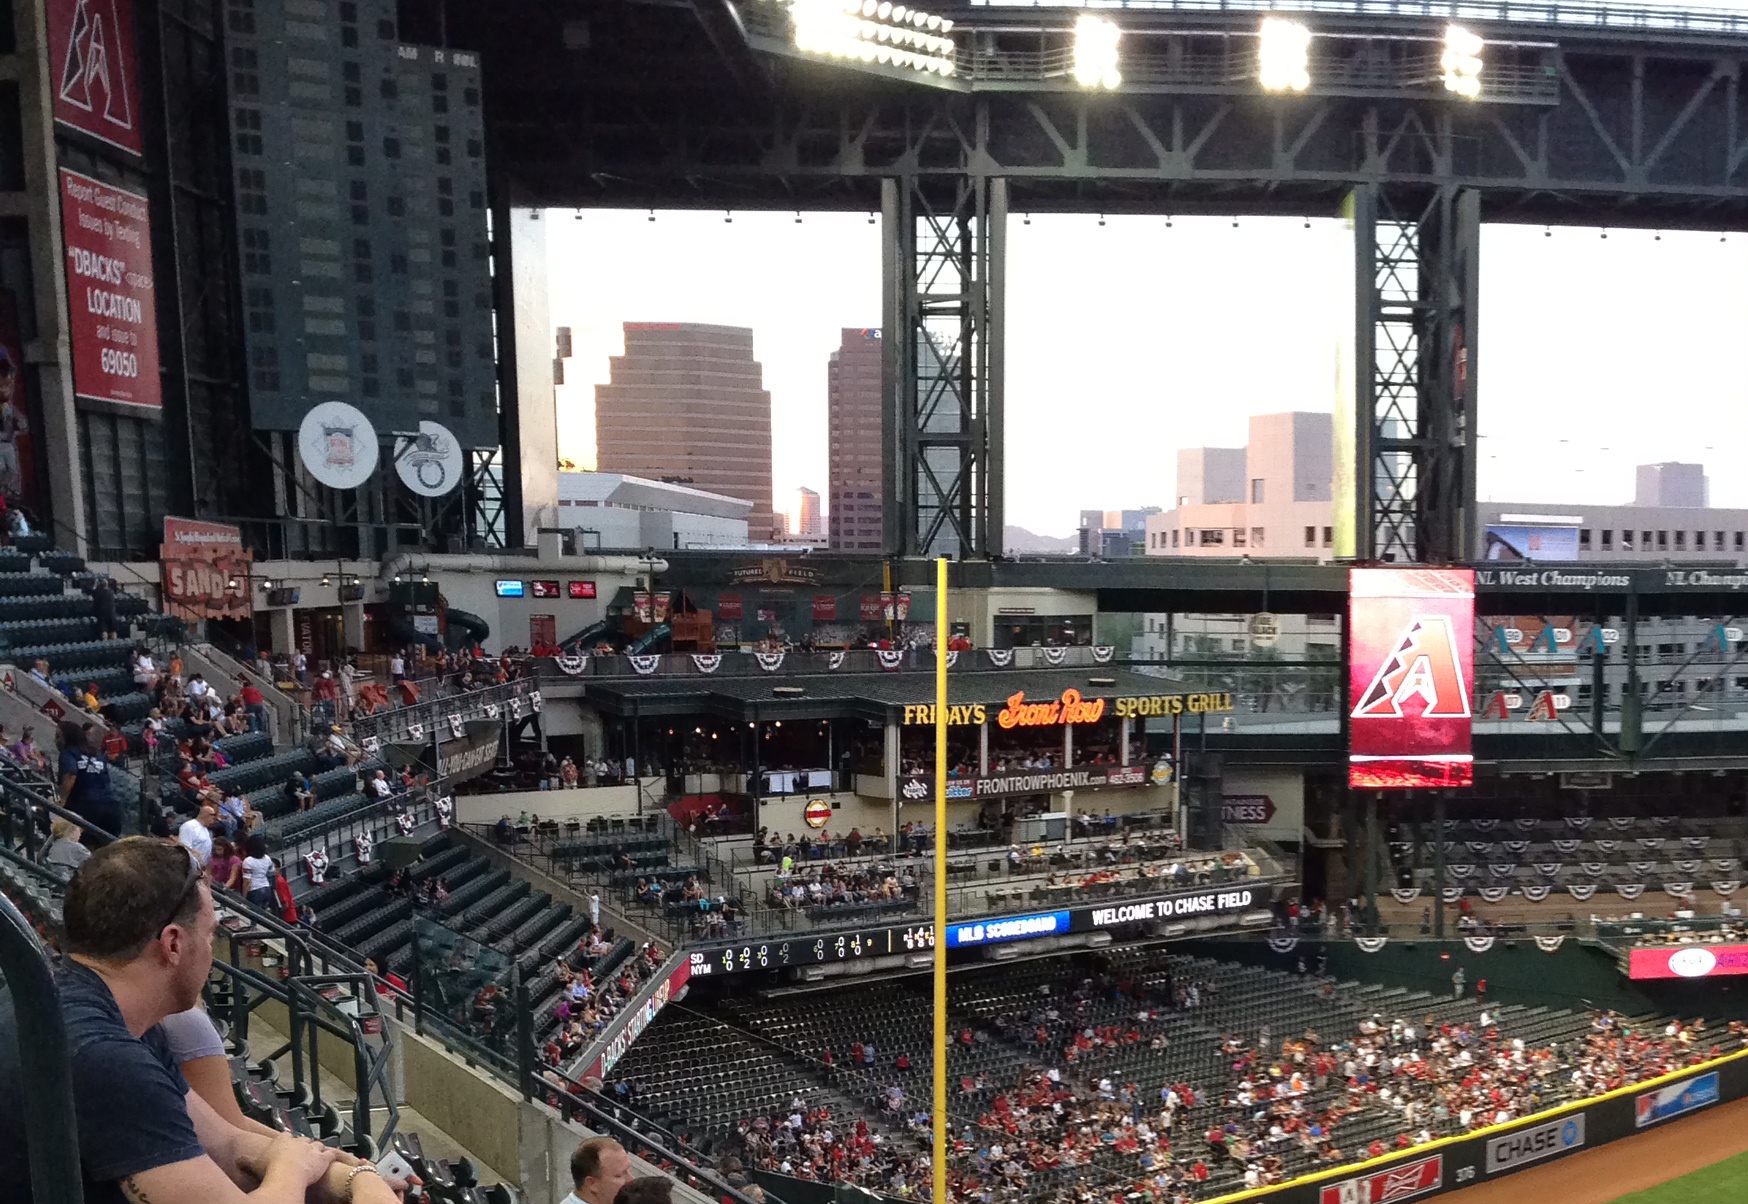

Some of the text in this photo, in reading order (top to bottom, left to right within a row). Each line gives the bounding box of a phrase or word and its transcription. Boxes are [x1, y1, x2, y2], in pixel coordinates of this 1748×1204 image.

[66, 176, 148, 222] Report Guest Conduct
[78, 208, 103, 232] Issues
[114, 221, 141, 249] Texting
[87, 287, 142, 324] LOCATION
[96, 325, 110, 340] and
[101, 347, 138, 378] 69050
[1475, 571, 1630, 589] NL West Champions
[998, 690, 1063, 729] Front
[1061, 688, 1105, 724] Row
[1115, 695, 1184, 717] SPORTS
[1186, 692, 1234, 713] GRILL
[976, 772, 1107, 795] FRONTROWPHOENIX.com
[1092, 890, 1252, 926] WELCOME TO CHASE FIELD
[958, 915, 1057, 943] MLB SCOREBOARD
[690, 952, 703, 964] SD
[690, 963, 712, 976] NYM
[1495, 1125, 1558, 1164] CHASE
